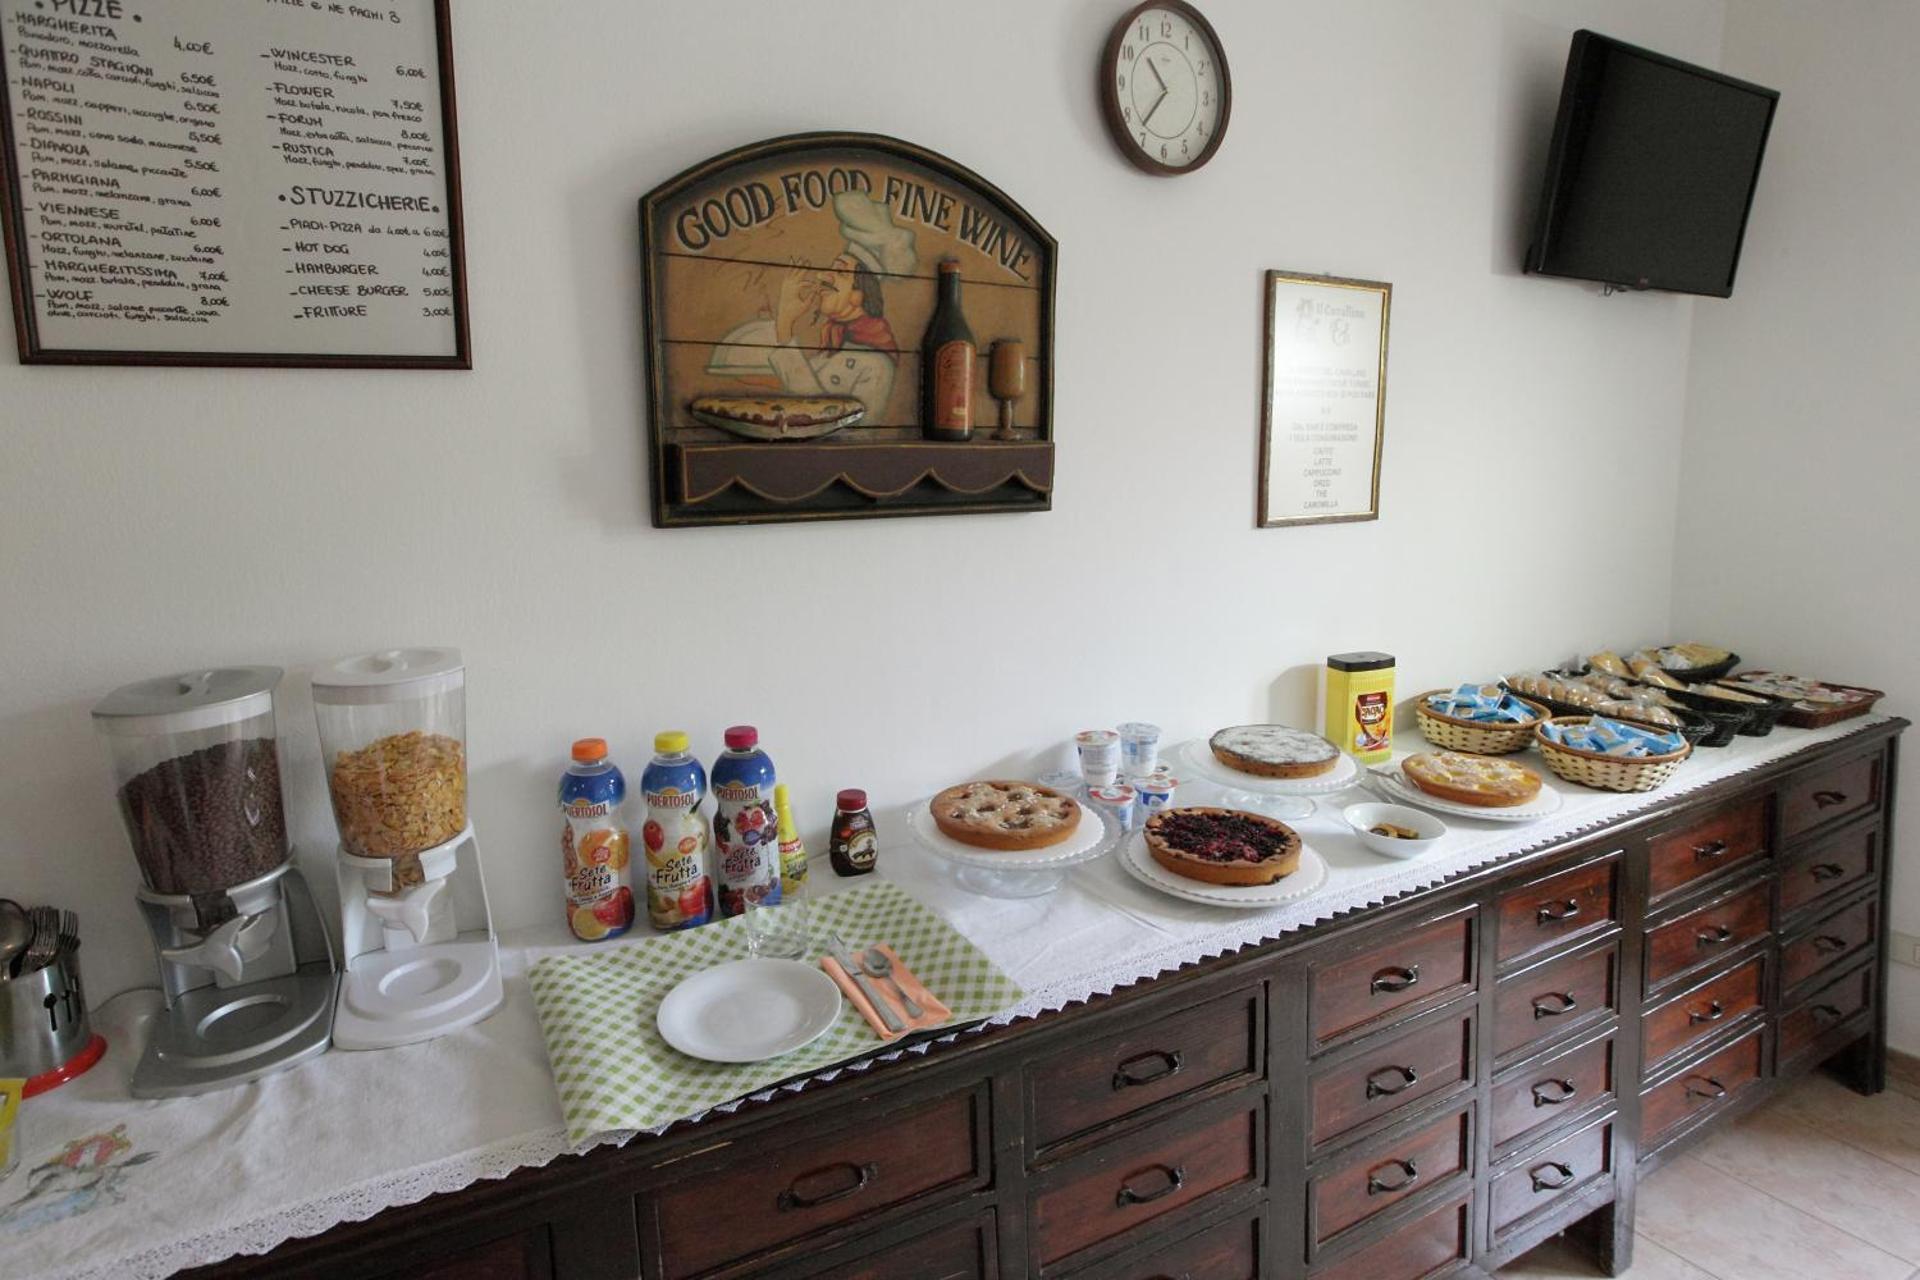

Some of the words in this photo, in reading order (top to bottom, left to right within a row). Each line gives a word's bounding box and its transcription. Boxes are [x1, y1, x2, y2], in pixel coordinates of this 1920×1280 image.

[328, 4, 345, 14] NE
[16, 11, 117, 40] MARGHERITA
[1139, 25, 1150, 42] 11
[1160, 20, 1172, 38] 12
[1184, 35, 1189, 50] 1
[270, 48, 356, 67] WINCESTER
[1122, 45, 1134, 61] 10
[90, 56, 154, 77] STAGIONI
[22, 76, 75, 94] NAPOLI
[274, 82, 335, 98] FLOWER
[1118, 75, 1125, 91] 9
[27, 107, 82, 126] ROSSINI
[278, 112, 324, 127] FORUM
[30, 137, 90, 156] DIAVOLA
[1139, 132, 1146, 148] 7
[1181, 140, 1188, 154] 5
[282, 142, 335, 157] RUSTICA
[1160, 144, 1167, 159] 6
[31, 168, 121, 189] PARMIGIANA
[290, 186, 430, 213] STUZZICHERIE
[38, 202, 120, 220] VIENNESE
[675, 181, 774, 251] GOOD
[780, 167, 872, 217] FOOD
[884, 174, 958, 232] FINE
[958, 201, 1032, 281] WINE
[41, 231, 122, 248] ORTOLANA
[295, 241, 319, 253] HOT
[323, 243, 350, 254] DOG
[295, 262, 379, 275] HAMBURGER
[47, 288, 94, 301] WOLF
[298, 284, 351, 297] CHEESE
[357, 285, 409, 298] BURGER
[303, 305, 367, 319] FRITTURE
[656, 863, 698, 884] Frutta
[571, 874, 612, 892] Frutta
